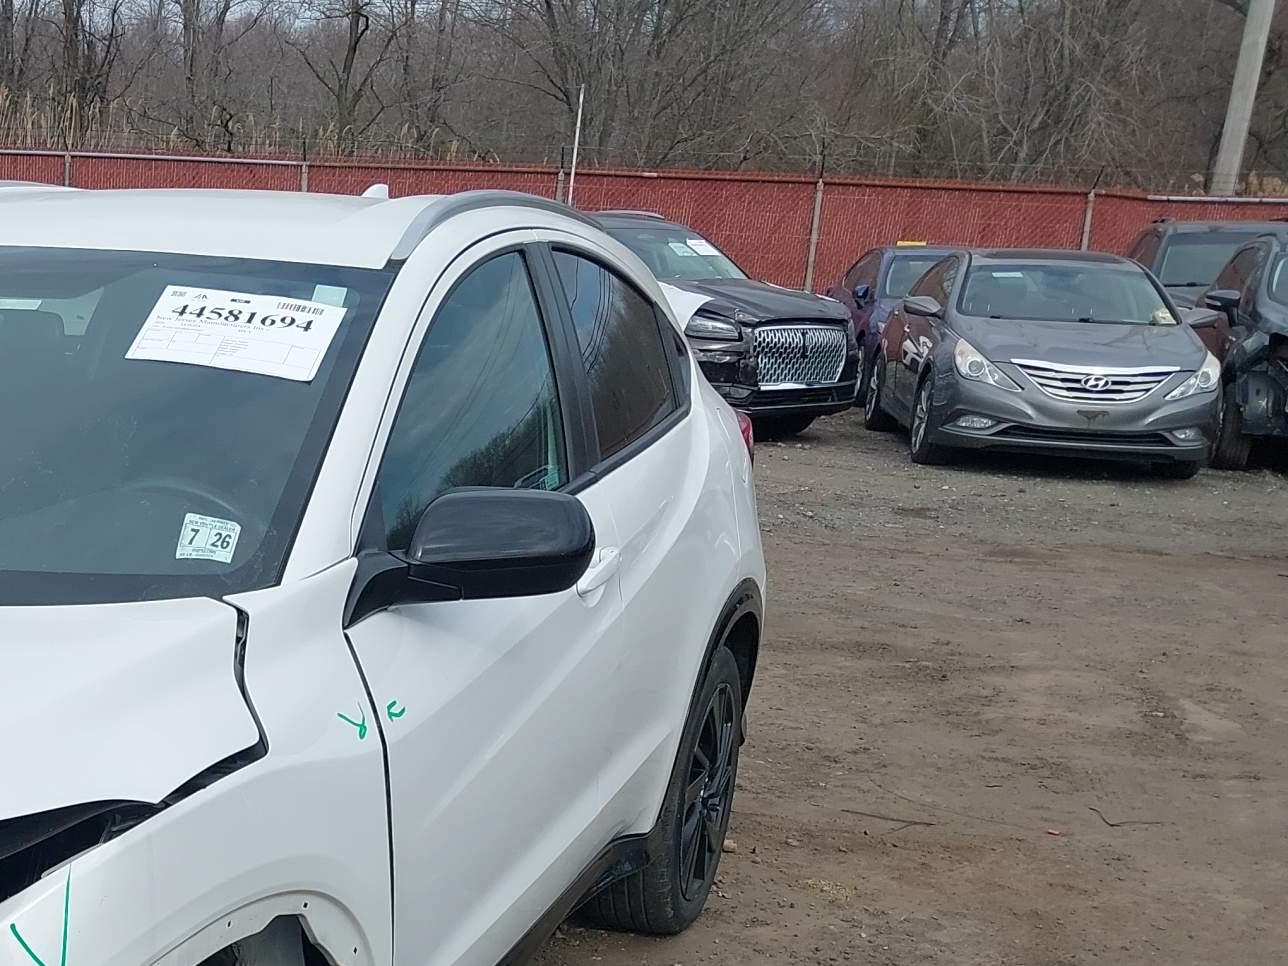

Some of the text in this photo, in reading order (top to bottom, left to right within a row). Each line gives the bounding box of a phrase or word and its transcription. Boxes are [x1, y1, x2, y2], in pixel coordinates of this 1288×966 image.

[171, 304, 314, 332] 44581694
[187, 528, 232, 549] 7 26
